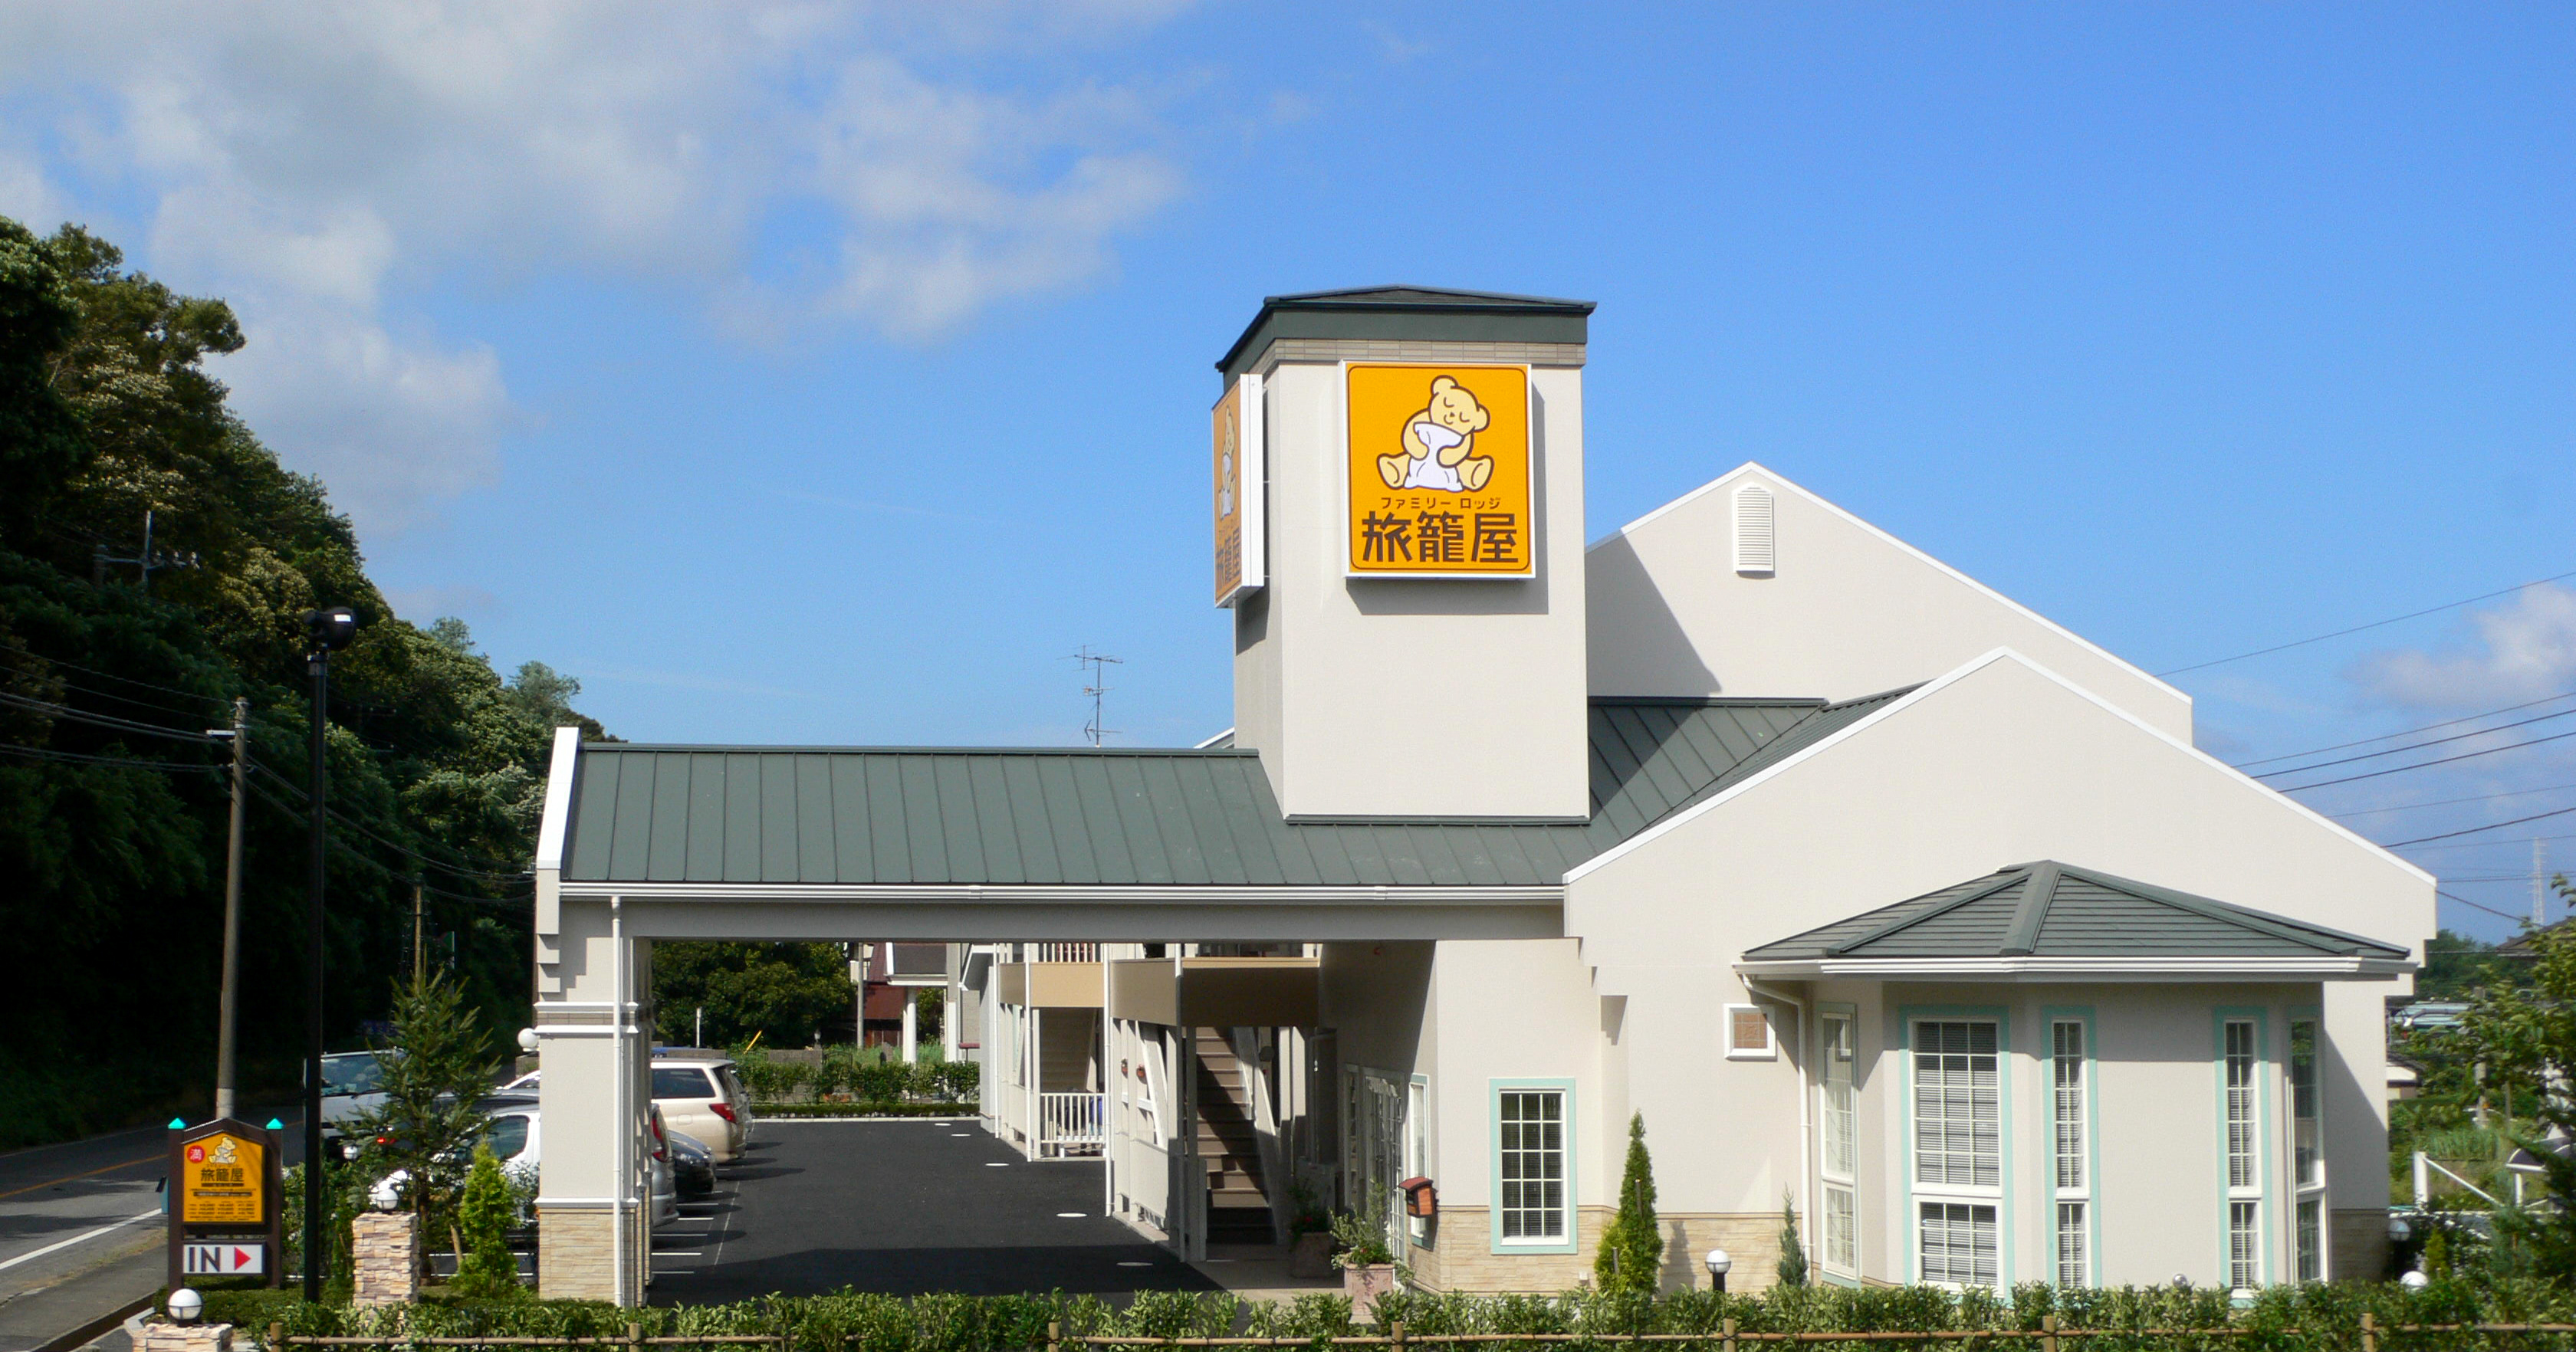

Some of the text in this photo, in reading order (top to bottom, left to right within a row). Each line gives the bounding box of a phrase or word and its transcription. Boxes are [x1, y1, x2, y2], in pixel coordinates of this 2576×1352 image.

[1381, 497, 1501, 510] ファミリー ロッジ
[1362, 510, 1519, 563] 旅籠屋
[201, 1168, 244, 1182] 旅籠屋
[189, 1247, 221, 1272] IN
